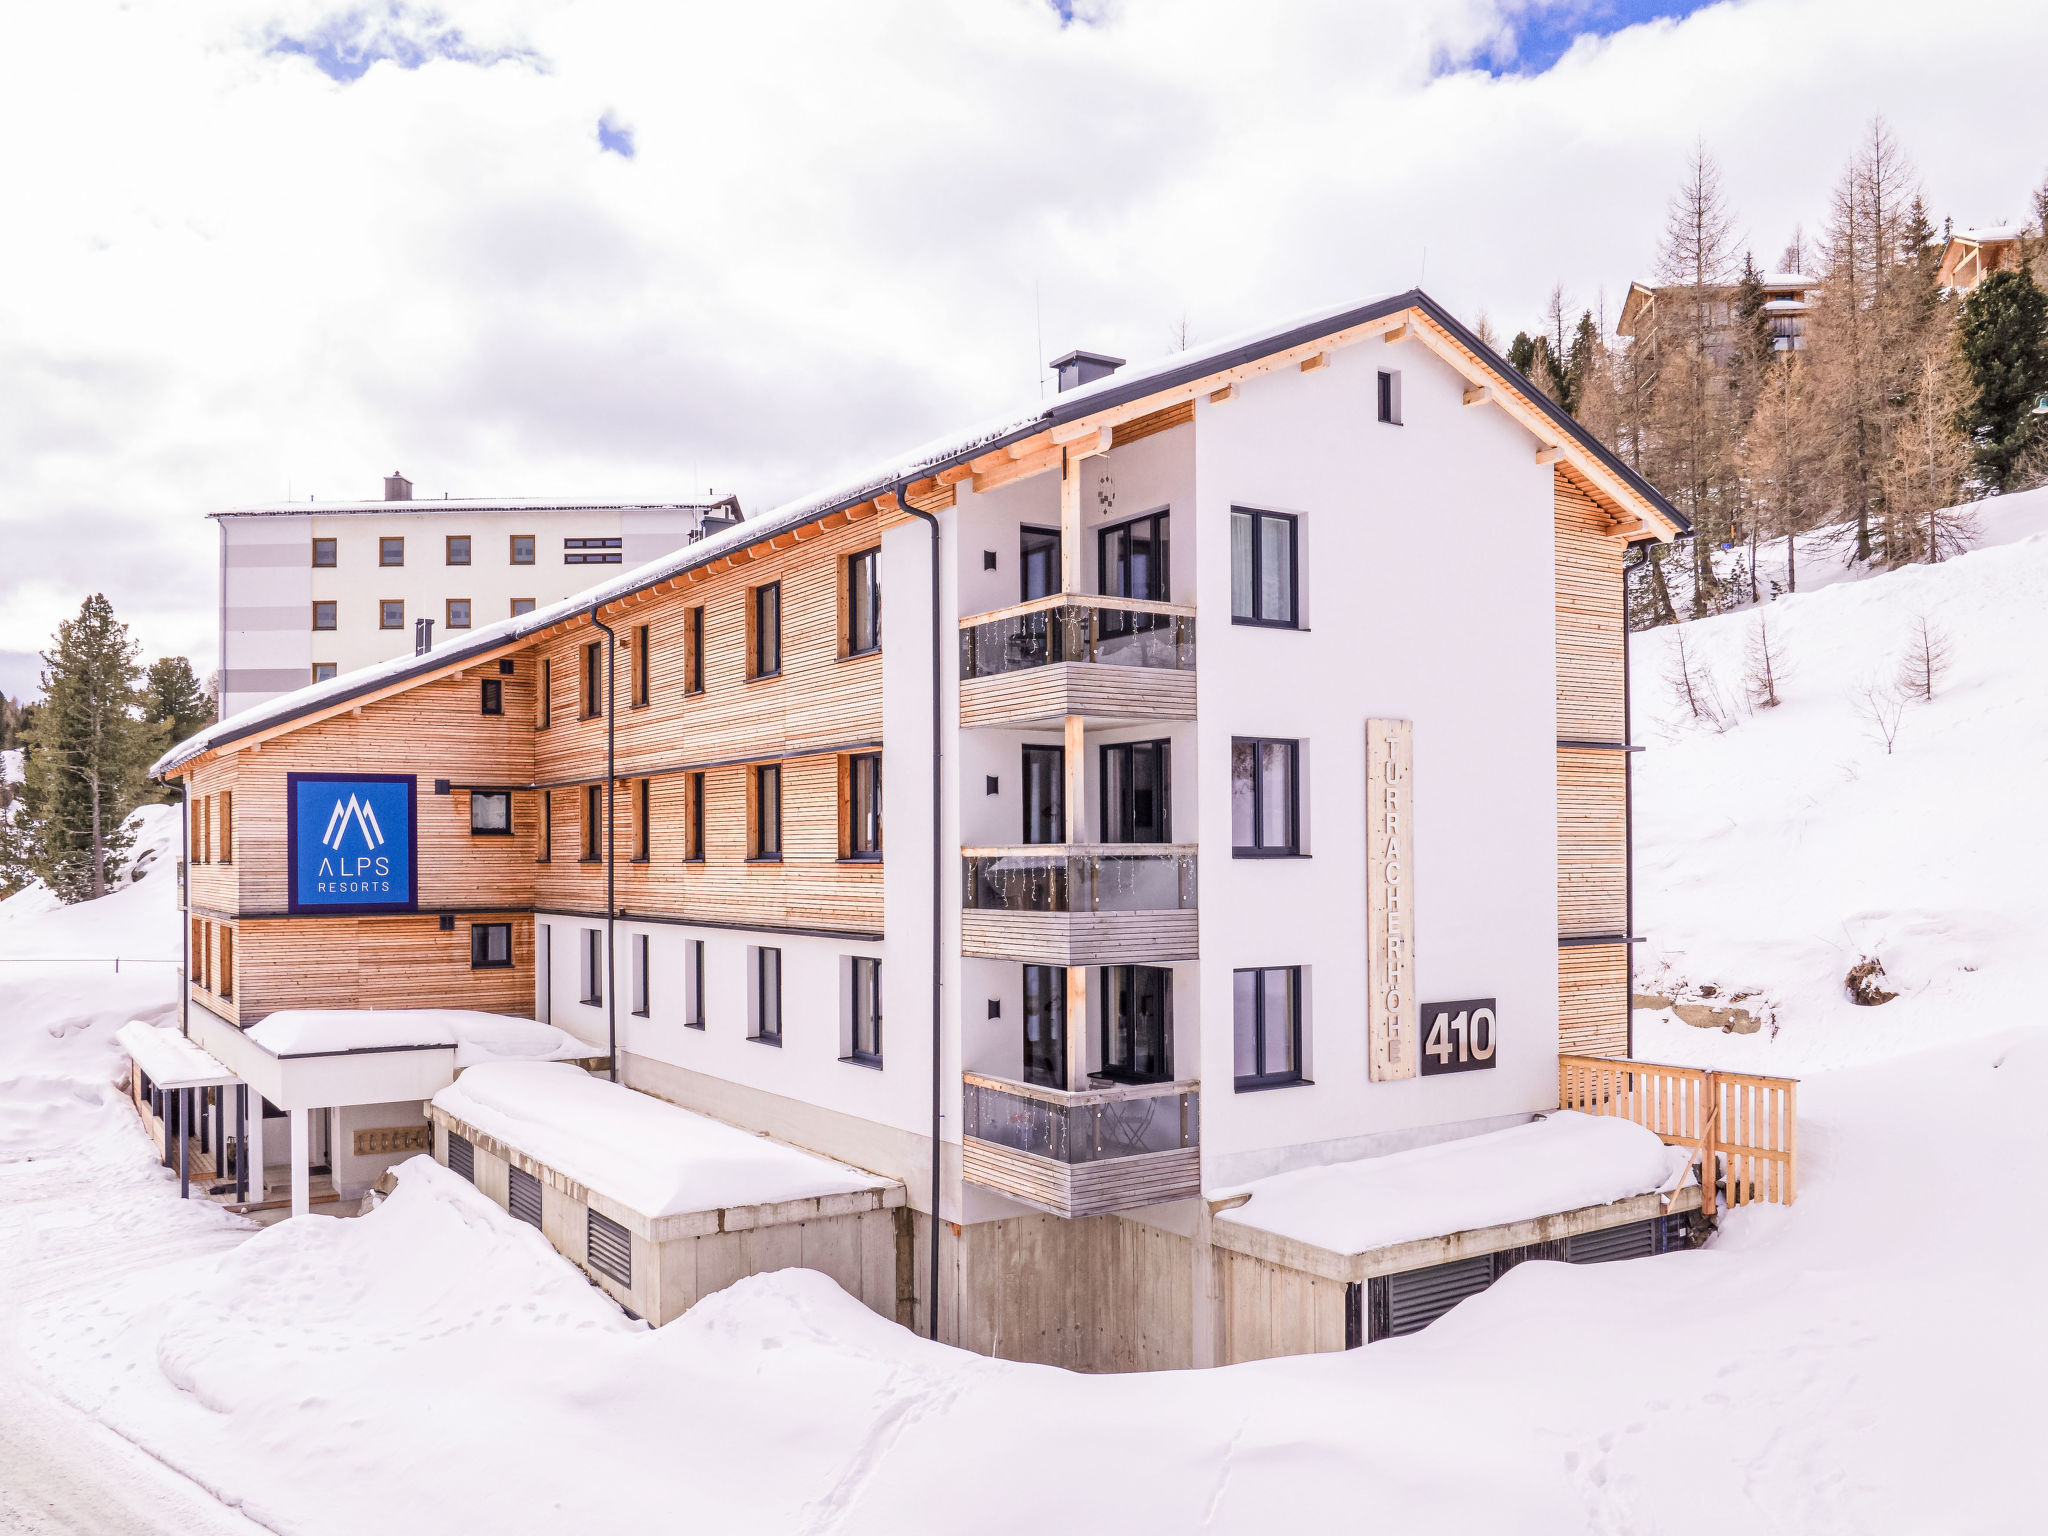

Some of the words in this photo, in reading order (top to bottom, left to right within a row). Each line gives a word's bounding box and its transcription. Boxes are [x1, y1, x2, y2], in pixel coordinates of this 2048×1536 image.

[318, 857, 389, 876] ALPS
[318, 882, 390, 893] RESORTS
[1425, 1007, 1496, 1065] 410
